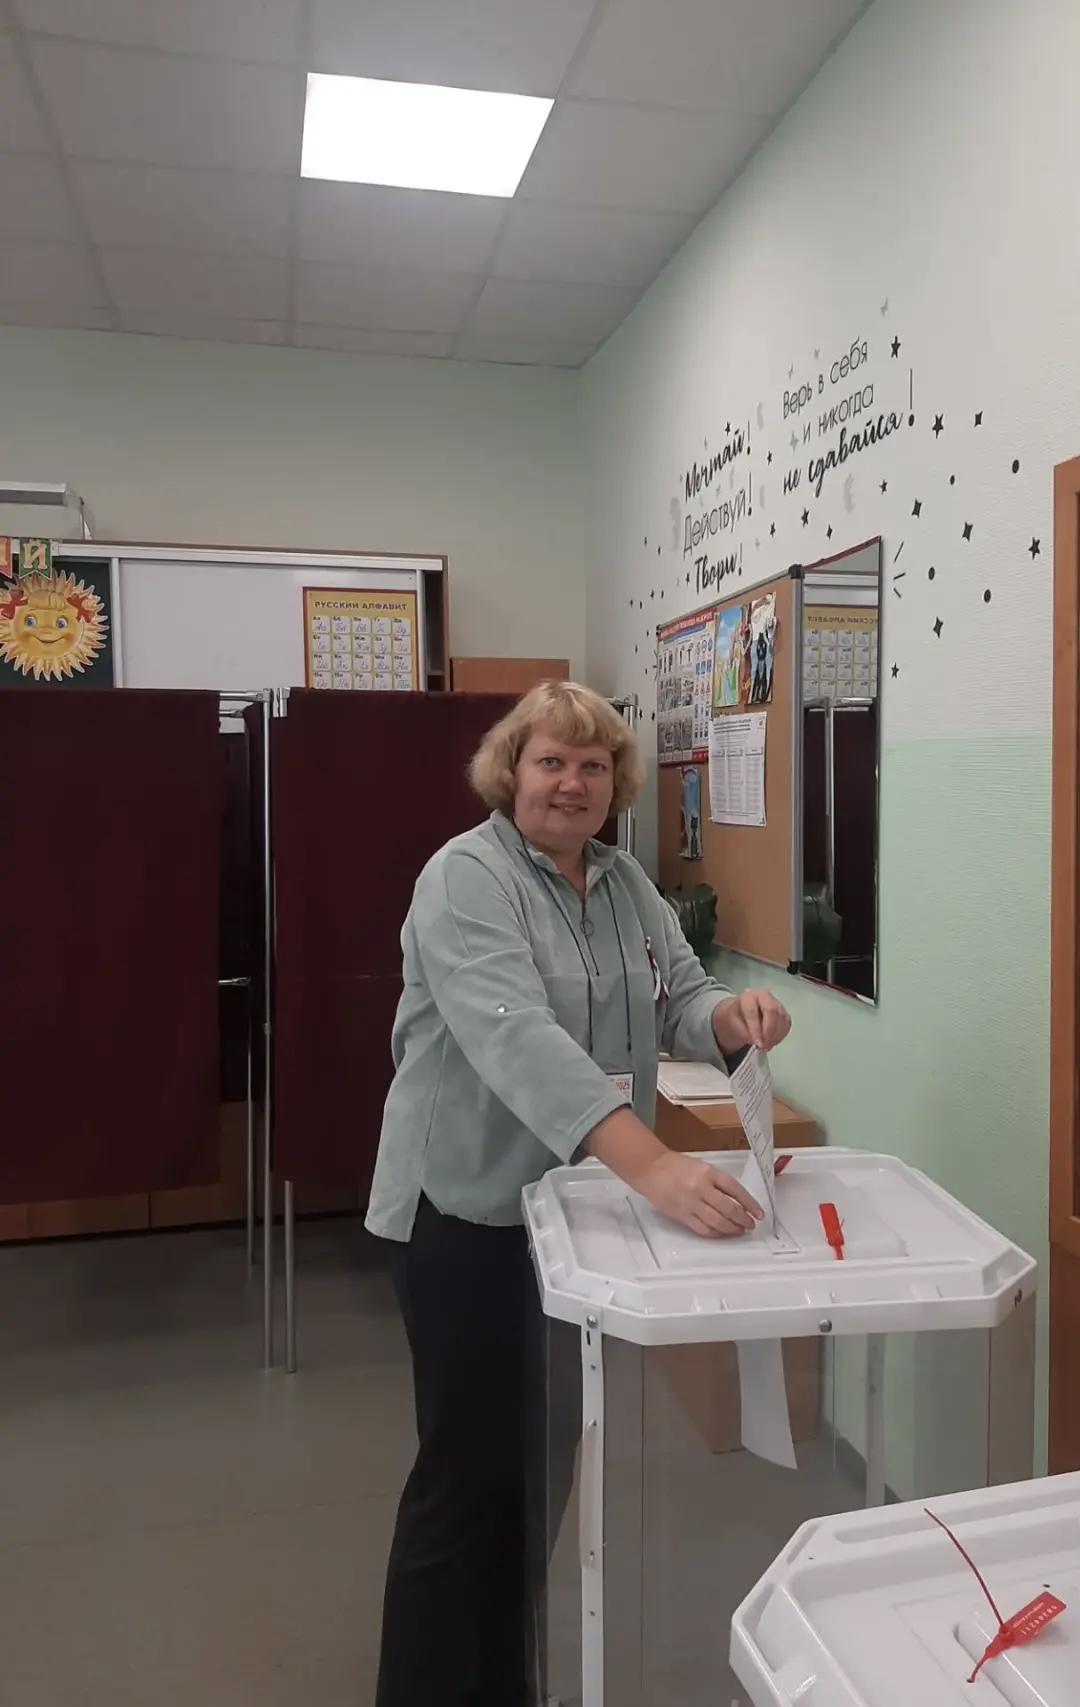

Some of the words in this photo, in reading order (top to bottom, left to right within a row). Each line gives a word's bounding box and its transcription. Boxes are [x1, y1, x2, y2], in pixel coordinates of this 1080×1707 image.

[783, 382, 813, 420] Верь
[818, 374, 825, 395] в
[830, 336, 868, 385] себя
[803, 421, 811, 445] и
[818, 383, 874, 437] никогда
[685, 420, 751, 504] Мечтай!
[783, 467, 802, 496] не
[808, 368, 915, 499] сдавайся!
[683, 470, 752, 561] Действуй!
[362, 602, 408, 611] АЛФАВИТ
[694, 542, 743, 595] Твори!
